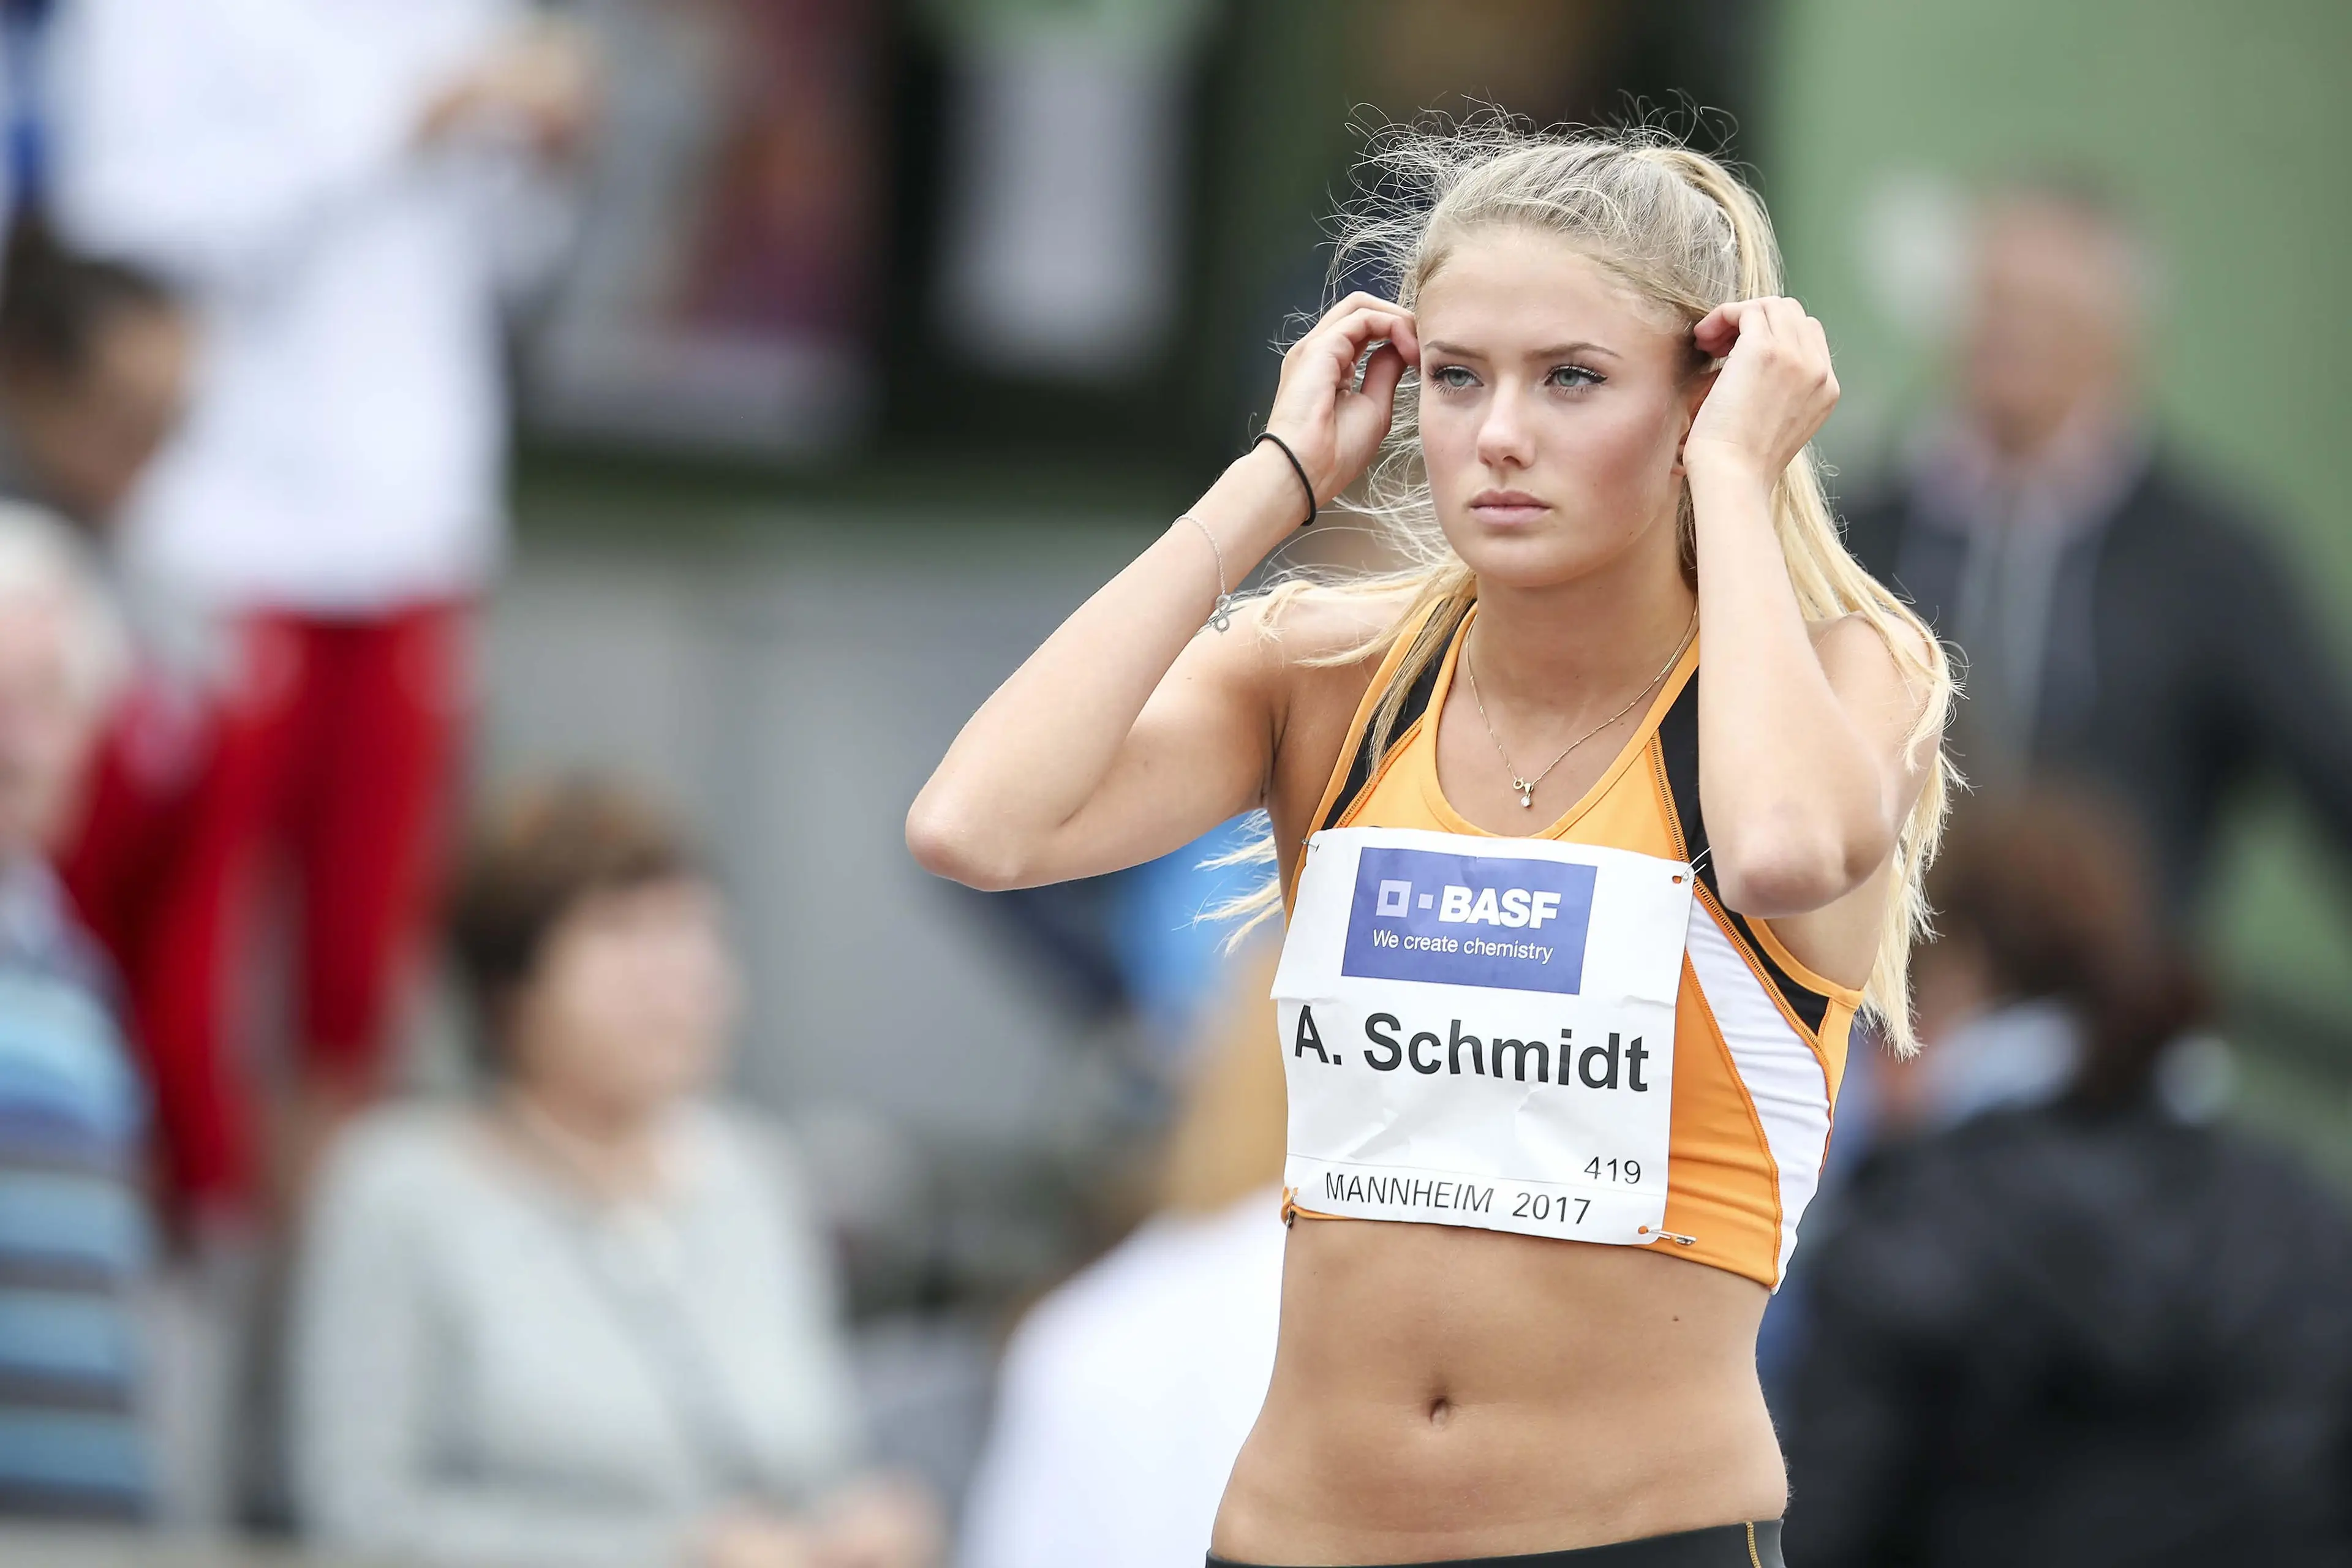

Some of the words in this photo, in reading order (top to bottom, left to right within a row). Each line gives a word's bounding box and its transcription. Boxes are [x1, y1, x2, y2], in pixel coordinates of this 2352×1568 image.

[1438, 884, 1561, 929] BASF
[1372, 929, 1399, 949] We
[1403, 933, 1458, 954] create
[1463, 937, 1553, 964] chemistry
[1295, 1005, 1342, 1065] A.
[1363, 1012, 1649, 1092] Schmidt
[1583, 1156, 1642, 1185] 419
[1325, 1172, 1494, 1213] MANNHEIM
[1512, 1192, 1591, 1225] 2017
